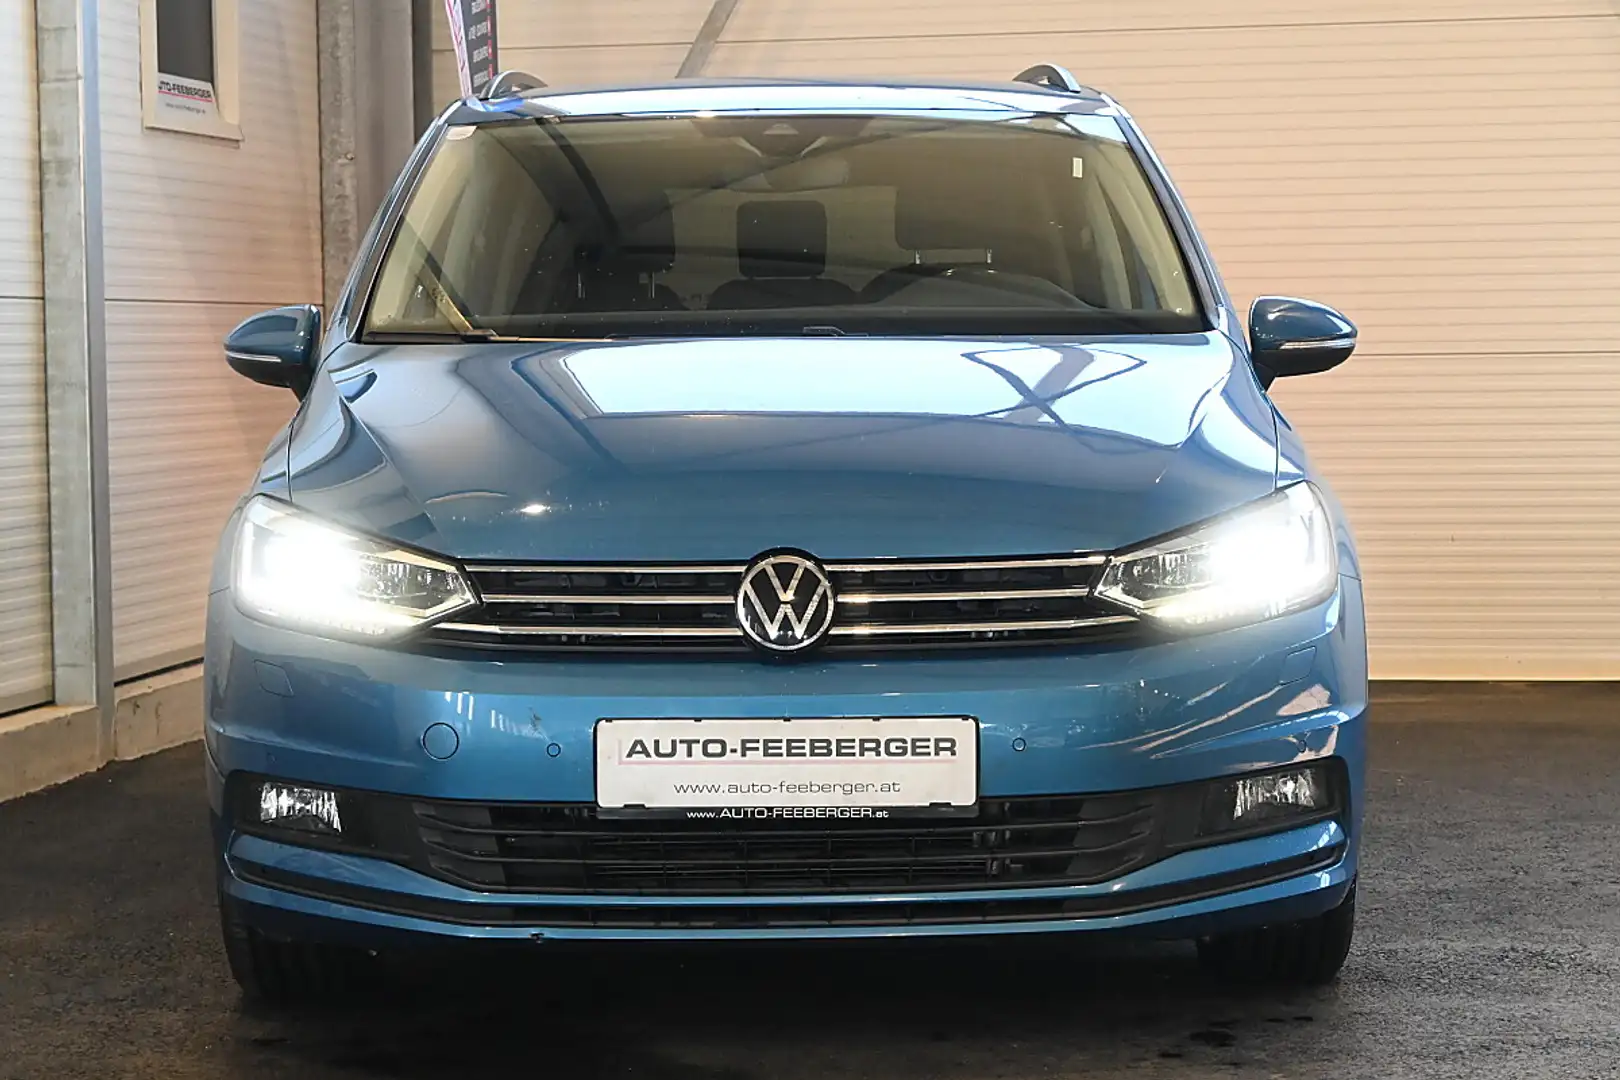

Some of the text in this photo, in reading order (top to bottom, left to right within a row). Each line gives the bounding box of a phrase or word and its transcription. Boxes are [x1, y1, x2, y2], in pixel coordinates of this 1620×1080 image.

[626, 738, 957, 759] AUTO-FEEBERGER
[673, 780, 901, 796] www.auto-feeberger.at
[686, 807, 889, 819] www.AUTO-FEEBERGER.at
